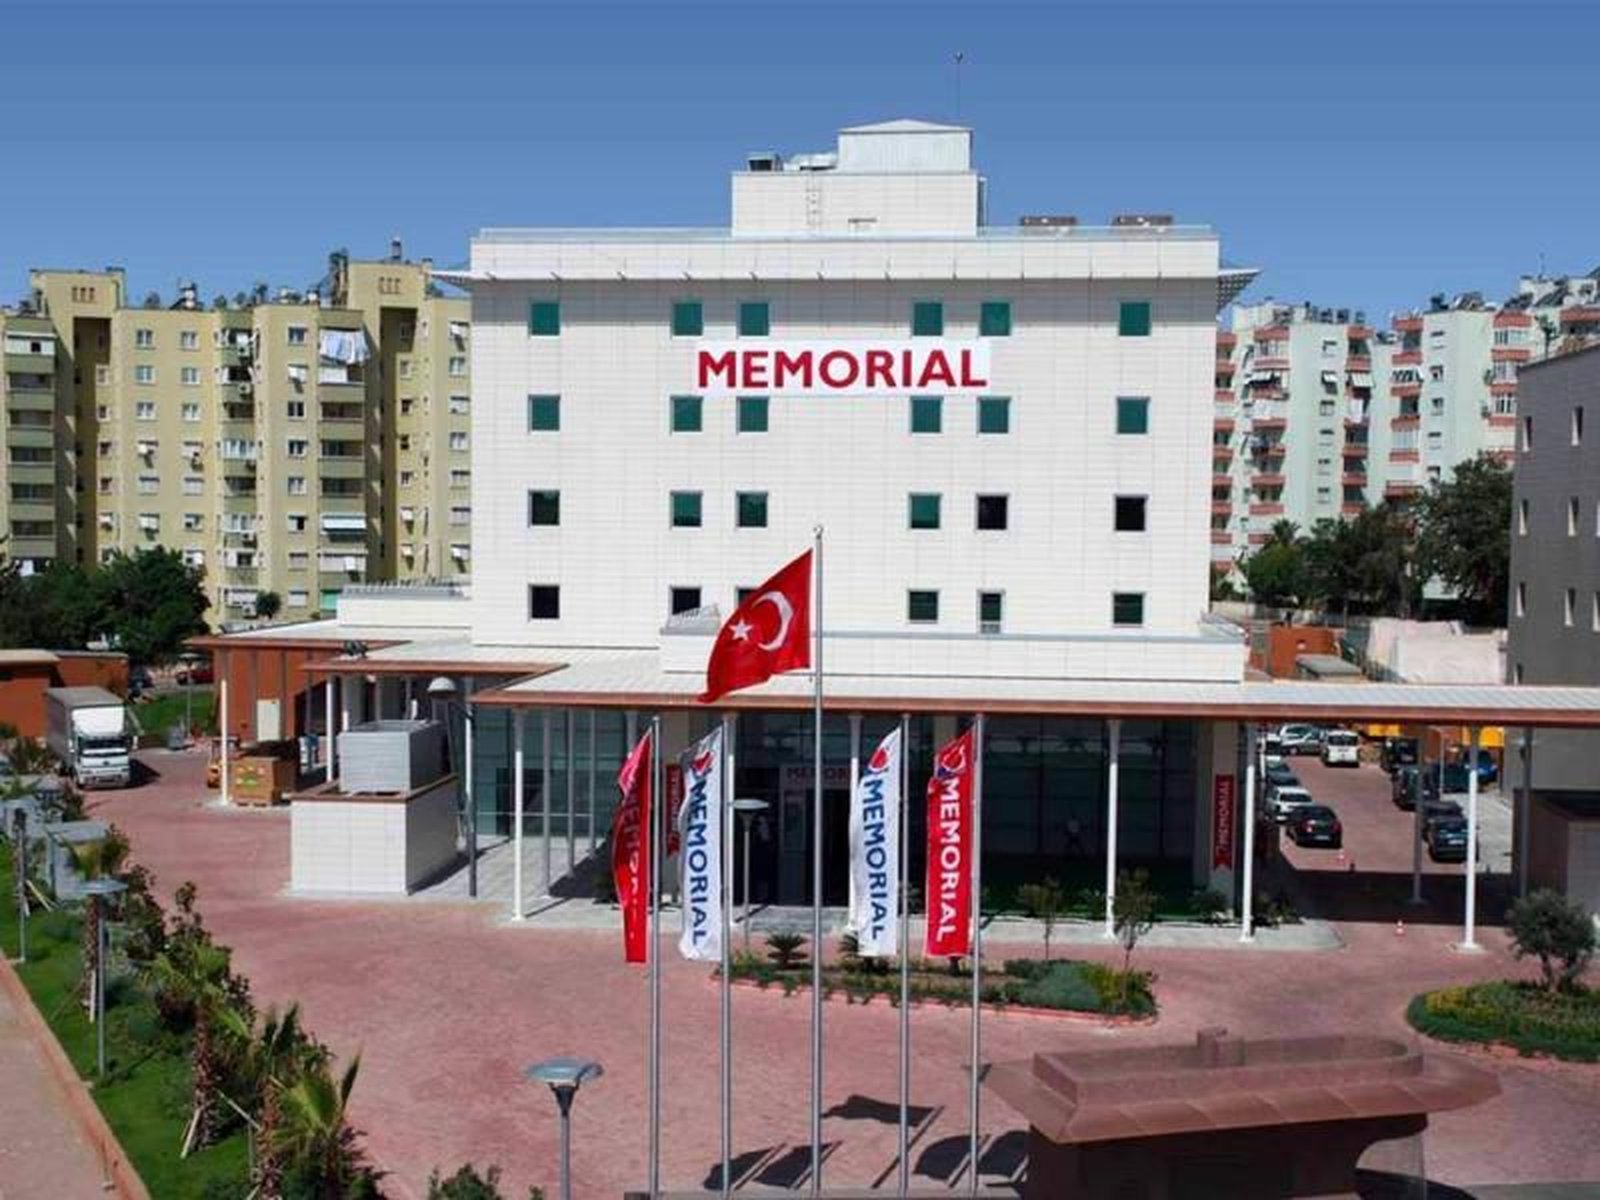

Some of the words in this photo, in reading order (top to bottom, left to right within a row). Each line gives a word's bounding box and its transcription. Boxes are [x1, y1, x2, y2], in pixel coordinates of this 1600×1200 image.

[698, 350, 987, 388] MEMORIAL
[687, 779, 708, 946] MEMORIAL
[863, 779, 887, 941] MEMORIAL
[936, 776, 960, 942] MEMORIAL
